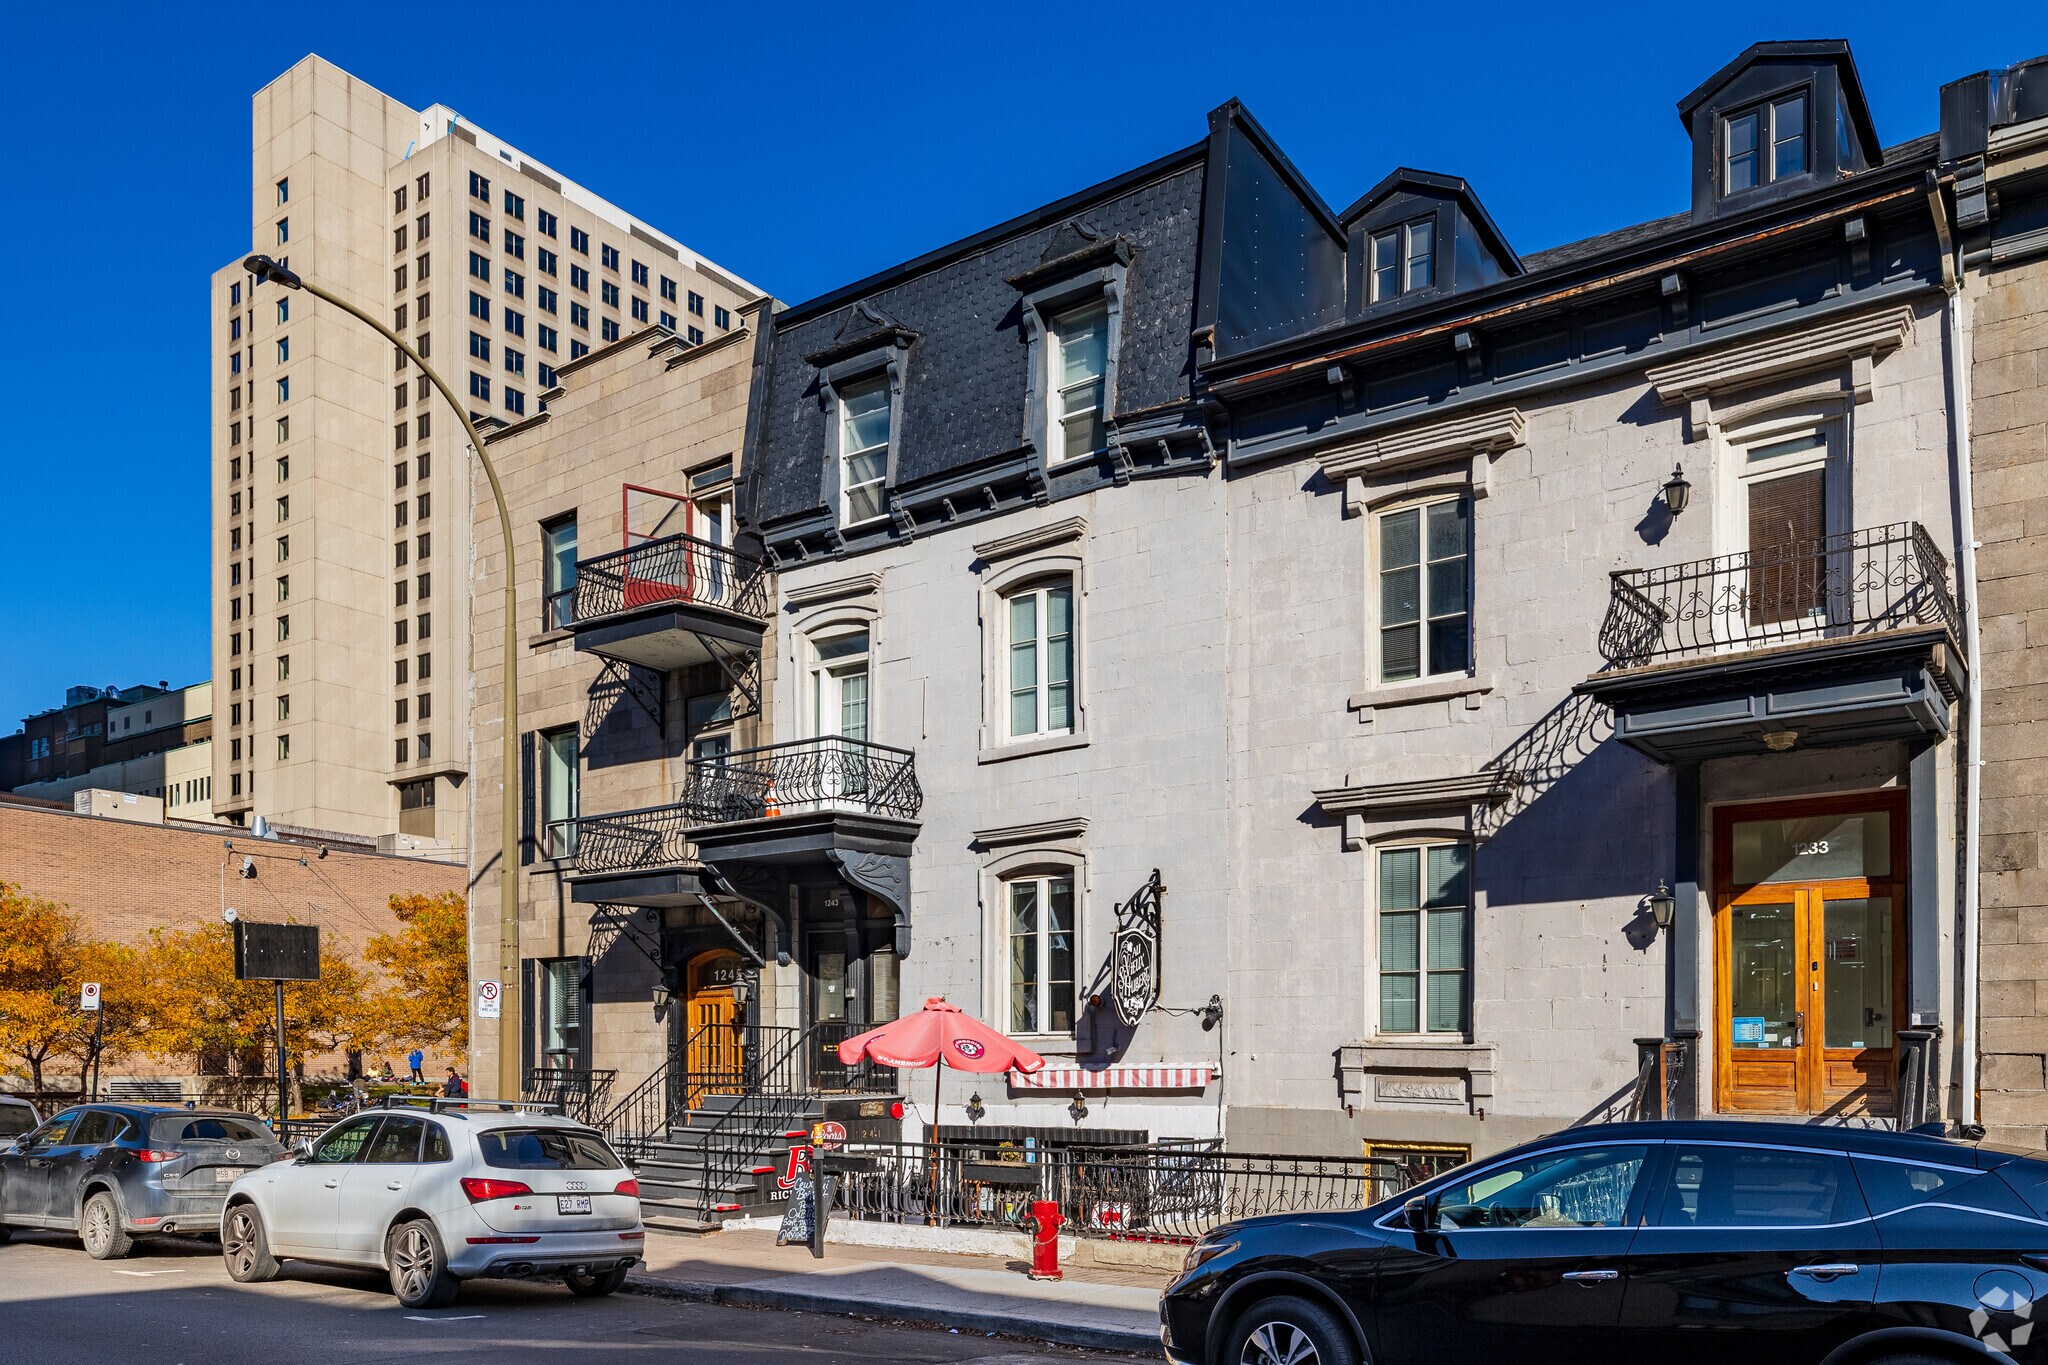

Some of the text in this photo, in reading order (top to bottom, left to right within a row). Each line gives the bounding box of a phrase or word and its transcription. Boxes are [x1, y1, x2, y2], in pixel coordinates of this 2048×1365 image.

[1792, 841, 1829, 855] 1233
[824, 899, 839, 907] 1243
[1131, 943, 1141, 959] AU
[714, 968, 742, 981] 1245
[560, 1199, 589, 1210] E27 RMP
